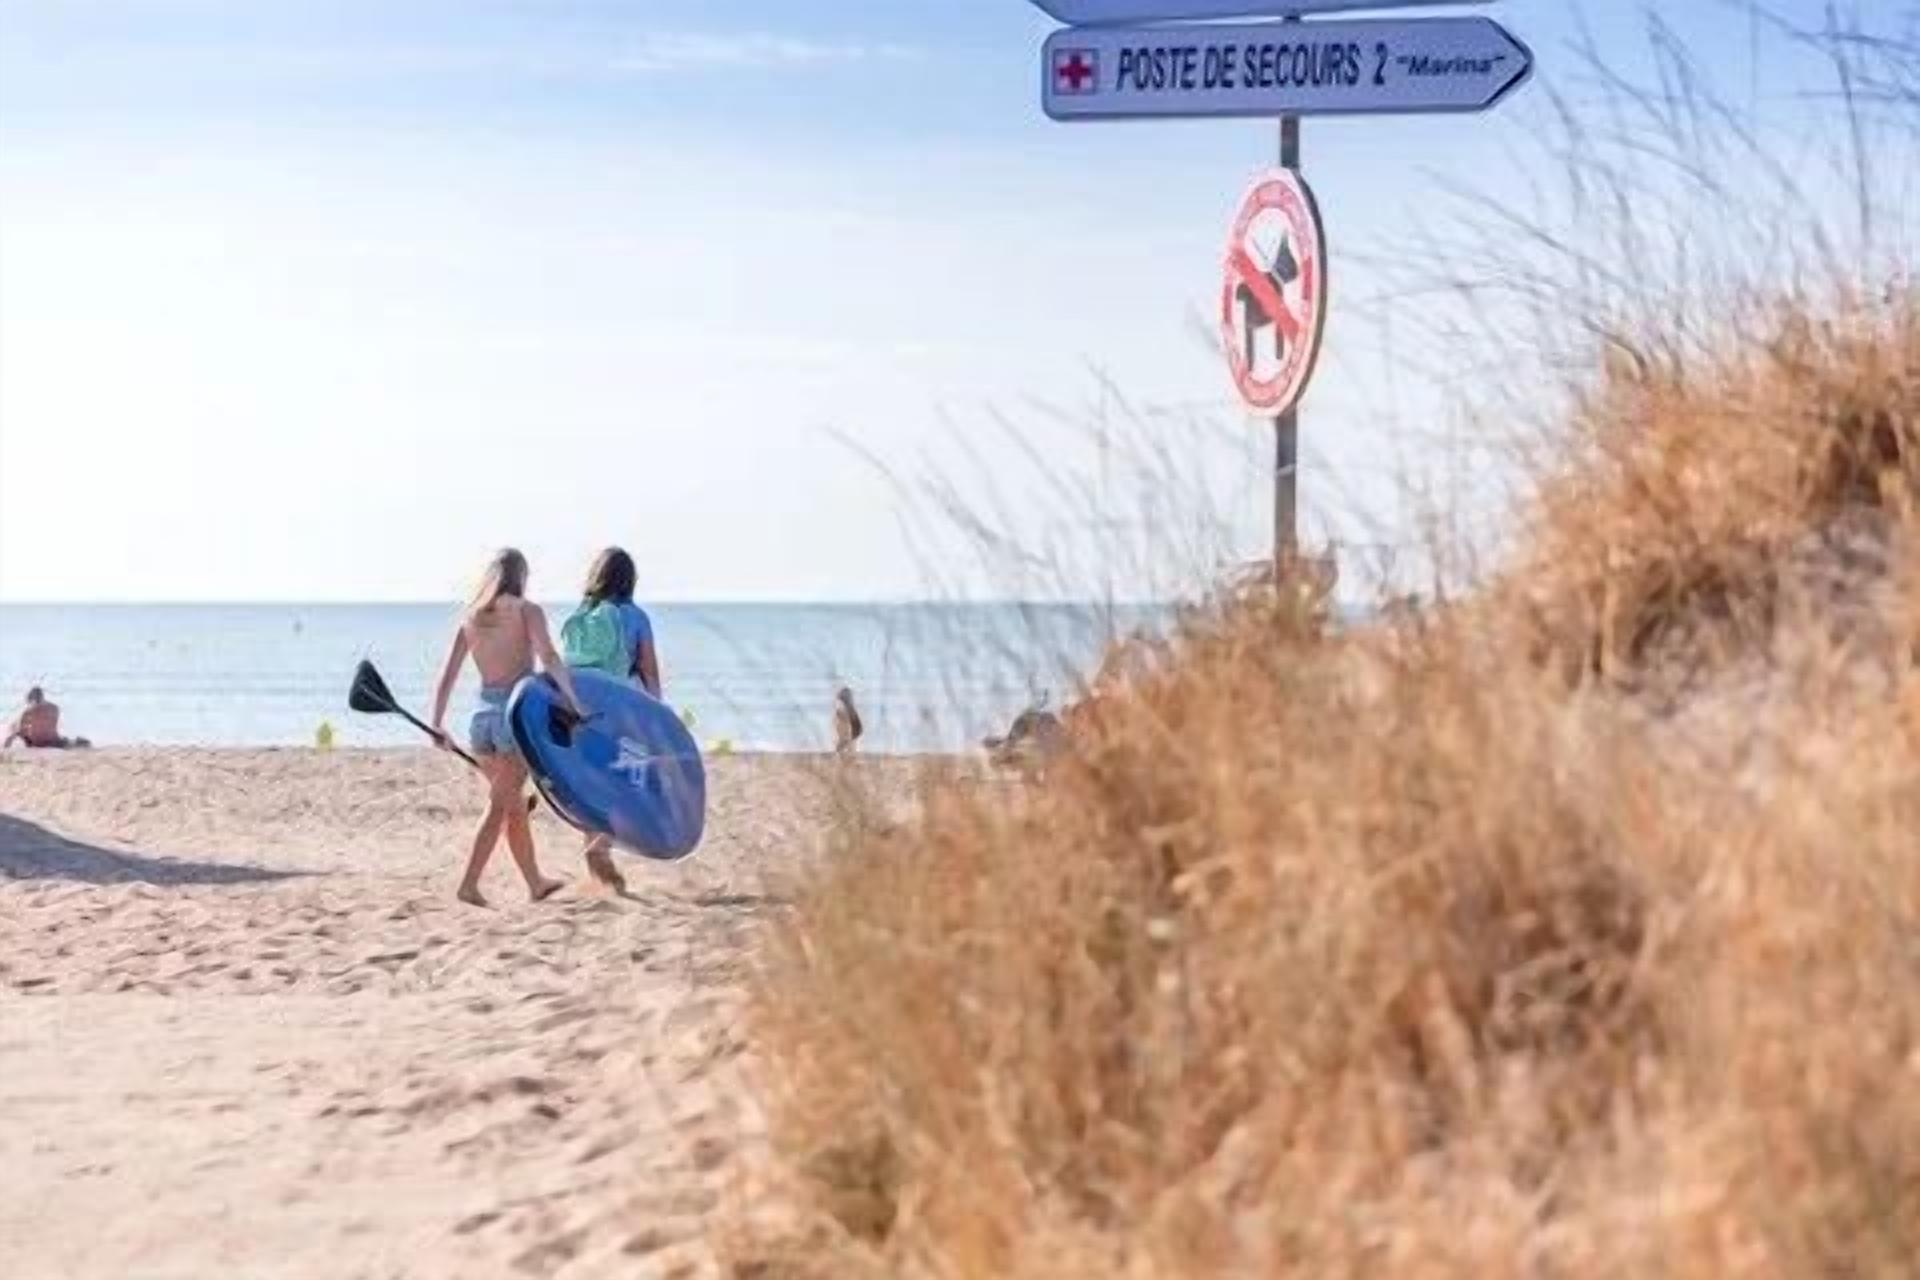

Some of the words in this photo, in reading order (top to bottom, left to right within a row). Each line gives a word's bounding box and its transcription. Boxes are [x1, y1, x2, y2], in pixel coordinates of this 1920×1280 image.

[1116, 47, 1198, 91] POSTE
[1203, 45, 1237, 88] DE
[1244, 43, 1361, 88] SECOURS
[1373, 42, 1388, 85] 2
